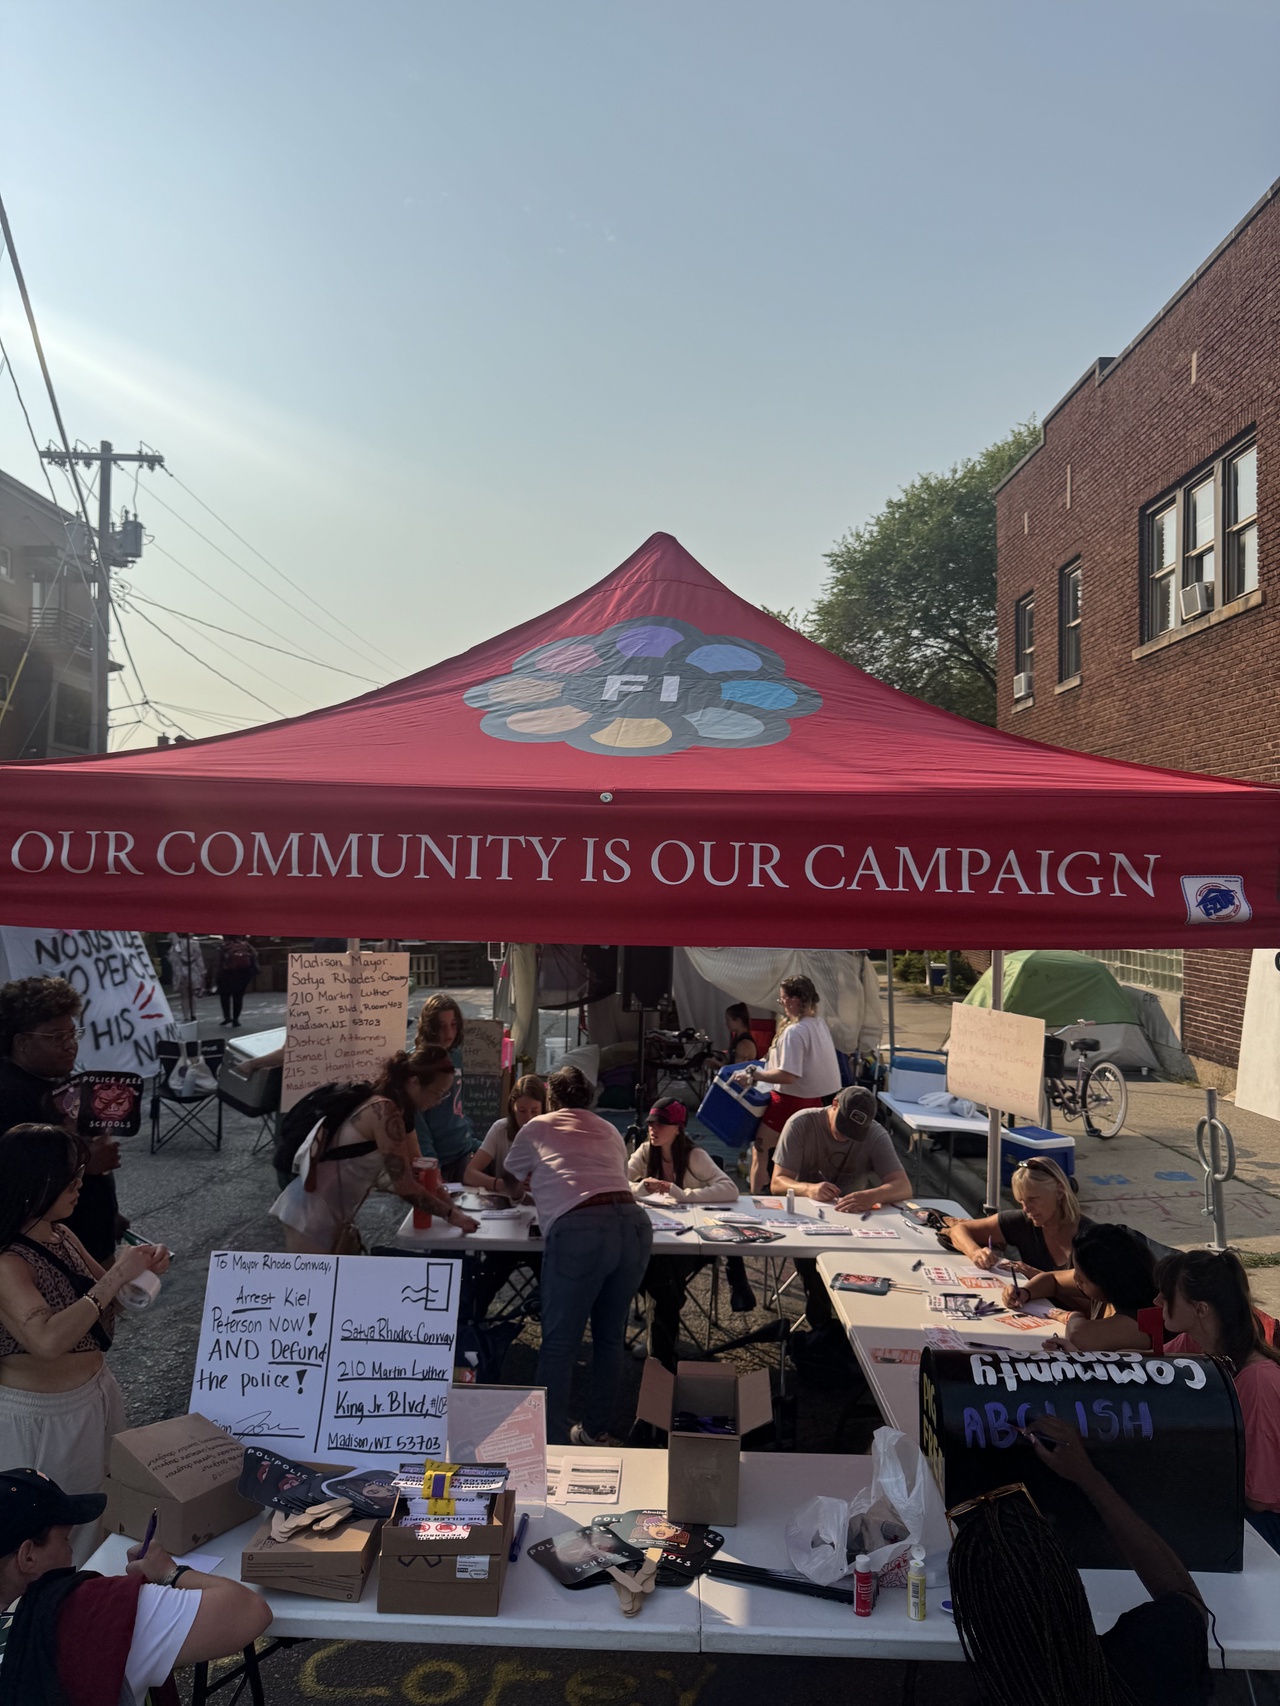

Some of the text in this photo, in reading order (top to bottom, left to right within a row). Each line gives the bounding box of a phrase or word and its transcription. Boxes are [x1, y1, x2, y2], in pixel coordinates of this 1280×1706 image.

[10, 830, 1161, 898] OUR COMMUNITY IS OUR CAMPAIGN
[94, 951, 156, 990] PEACE
[290, 954, 343, 969] Madison
[292, 972, 326, 990] Satya
[290, 988, 394, 1007] 210 Martin Luther
[289, 1008, 310, 1023] King
[91, 1008, 135, 1050] HIS
[288, 1034, 387, 1049] District Attorney
[285, 1050, 327, 1064] Ismael
[285, 1066, 305, 1079] 215
[326, 1060, 374, 1072] Hamilton
[82, 1076, 116, 1084] POLICE
[89, 1120, 131, 1128] SCHOOLS
[214, 1253, 228, 1269] To
[233, 1254, 259, 1274] Mayor
[262, 1254, 291, 1270] Rhodes
[236, 1286, 311, 1307] Arrest Kiel
[212, 1306, 262, 1334] Peterson
[341, 1319, 375, 1345] Satya
[208, 1338, 327, 1362] AND Defund
[337, 1360, 448, 1378] 210 Martin Luther
[970, 1352, 1206, 1392] Community
[196, 1368, 228, 1391] the
[335, 1391, 364, 1425] King
[368, 1394, 384, 1413] Jr.
[397, 1435, 441, 1451] 53703
